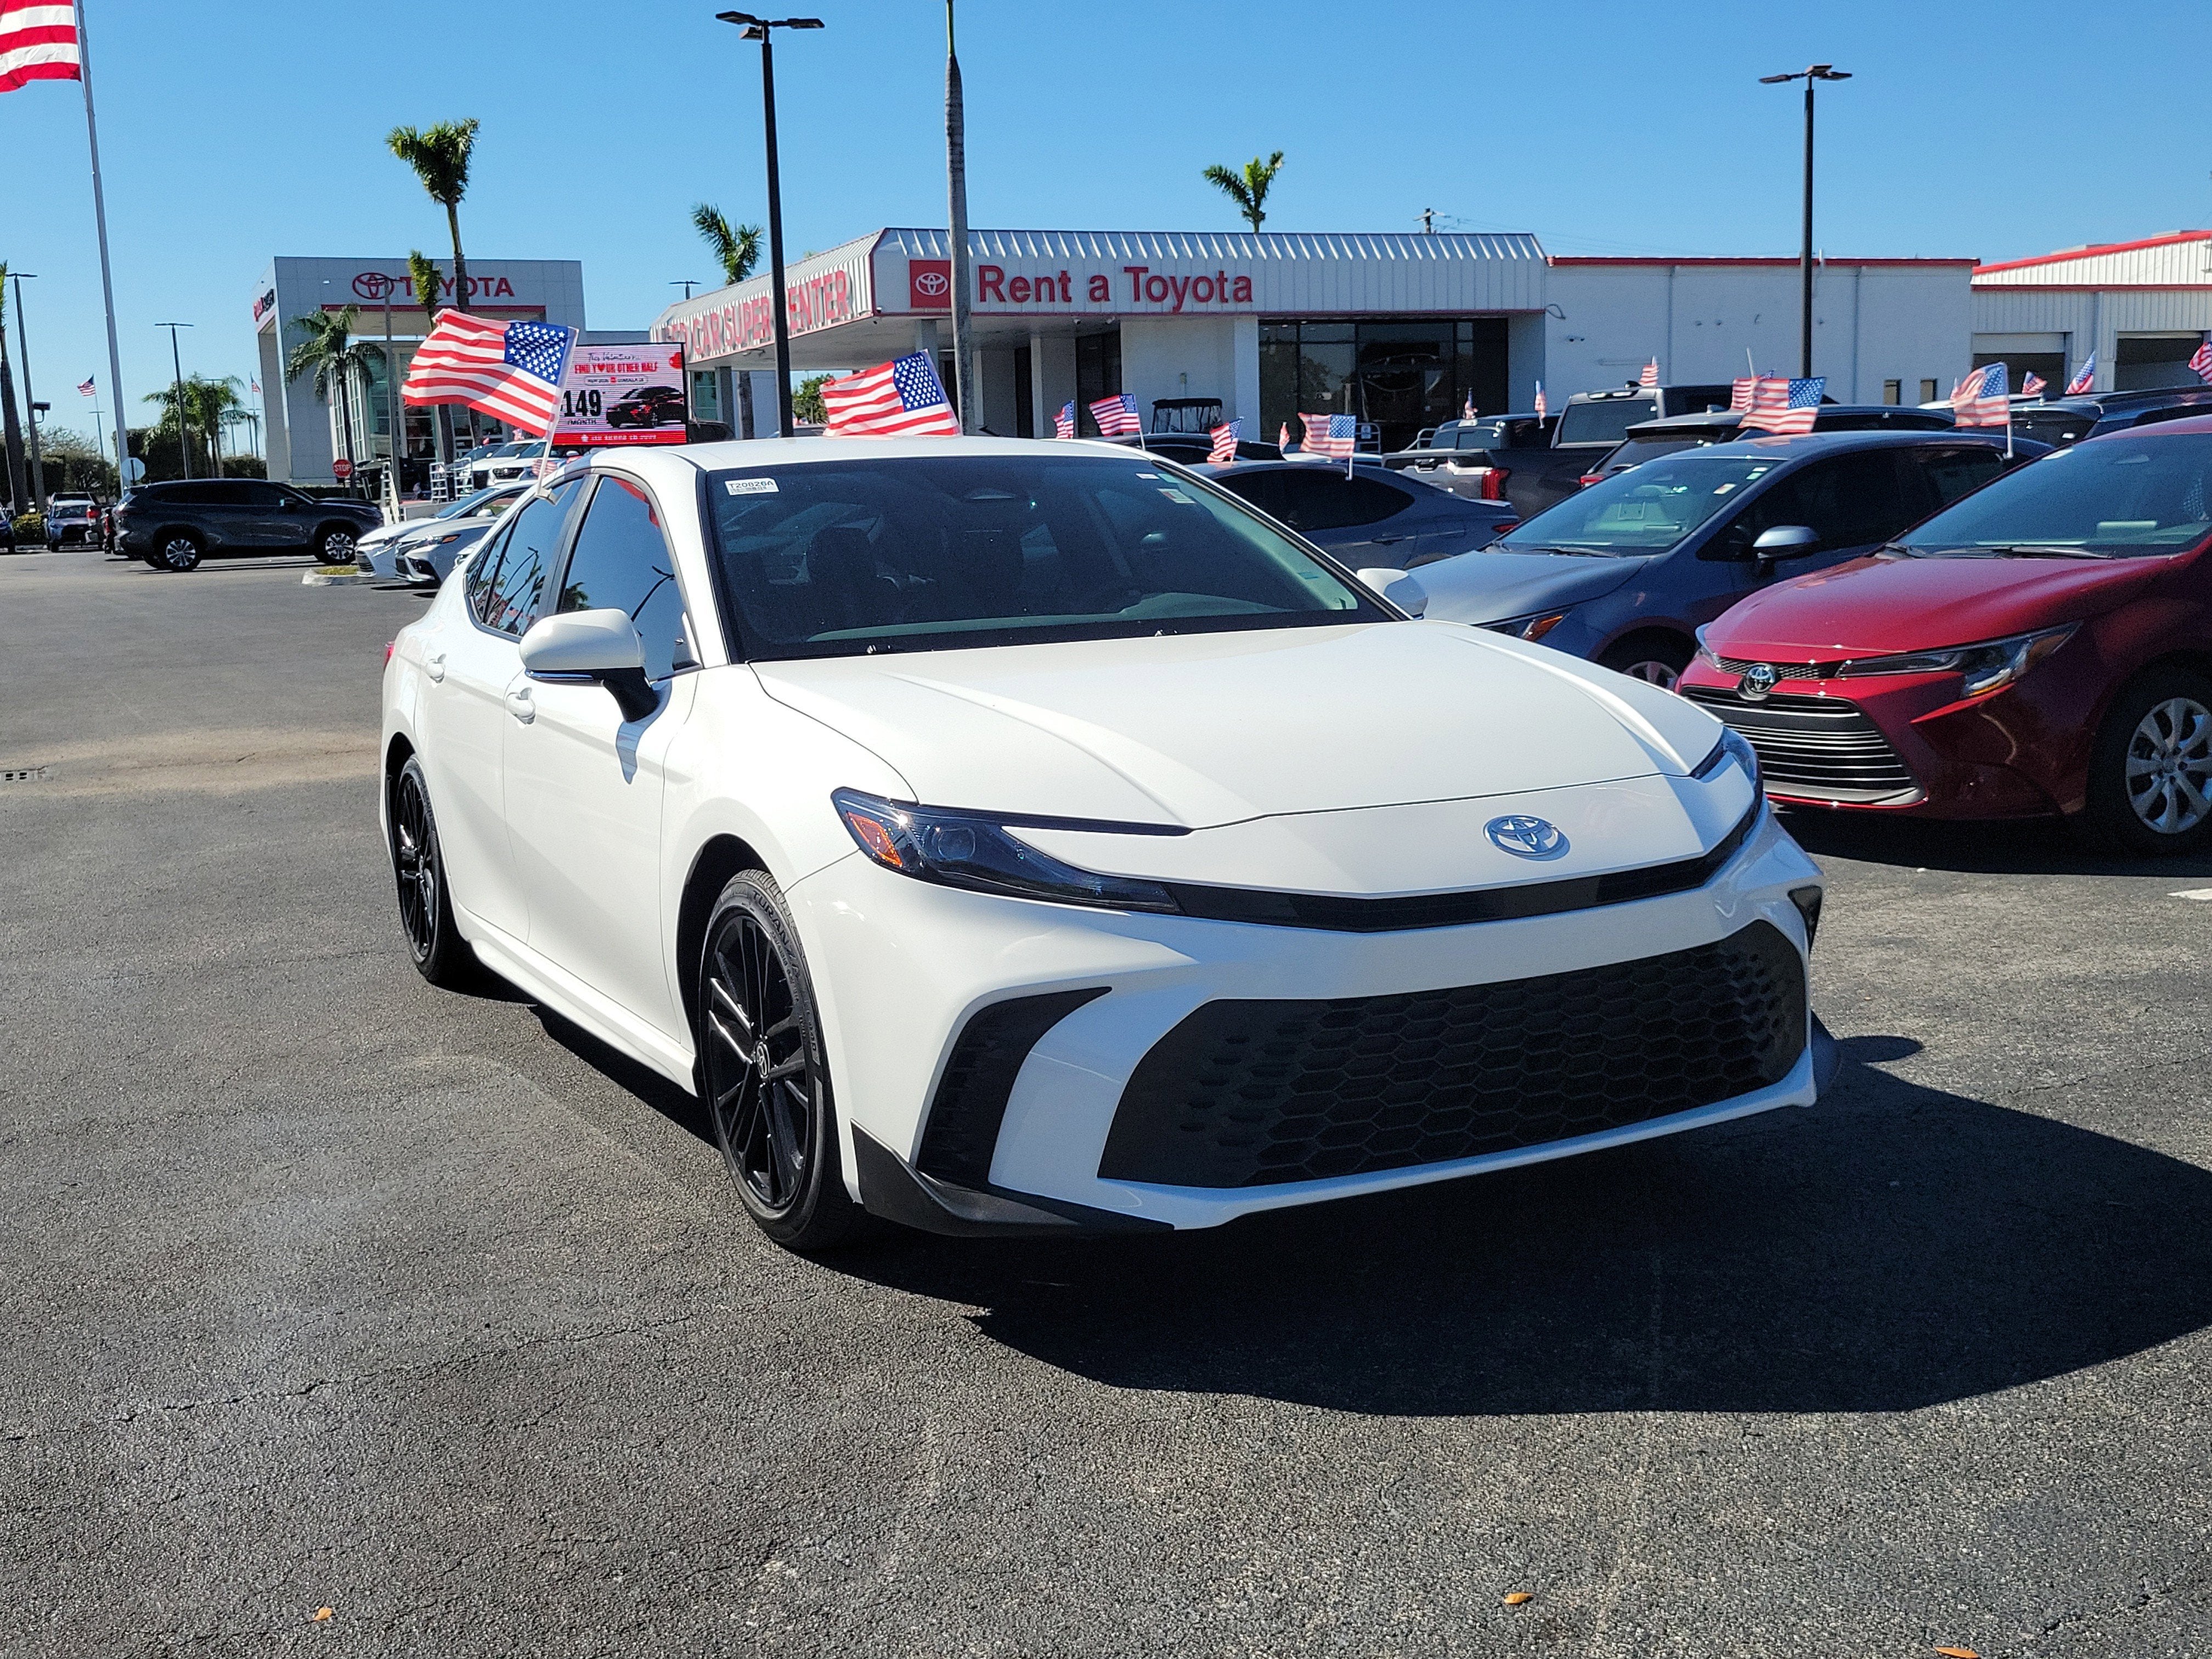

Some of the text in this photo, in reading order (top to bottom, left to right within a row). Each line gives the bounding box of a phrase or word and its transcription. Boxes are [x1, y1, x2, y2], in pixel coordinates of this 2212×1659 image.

[399, 276, 515, 297] TYOTA
[978, 264, 1253, 314] Rent a Toyota
[692, 312, 721, 355] CAR
[724, 296, 772, 347] SUPER
[788, 269, 850, 332] ENTER
[334, 464, 352, 472] STOP
